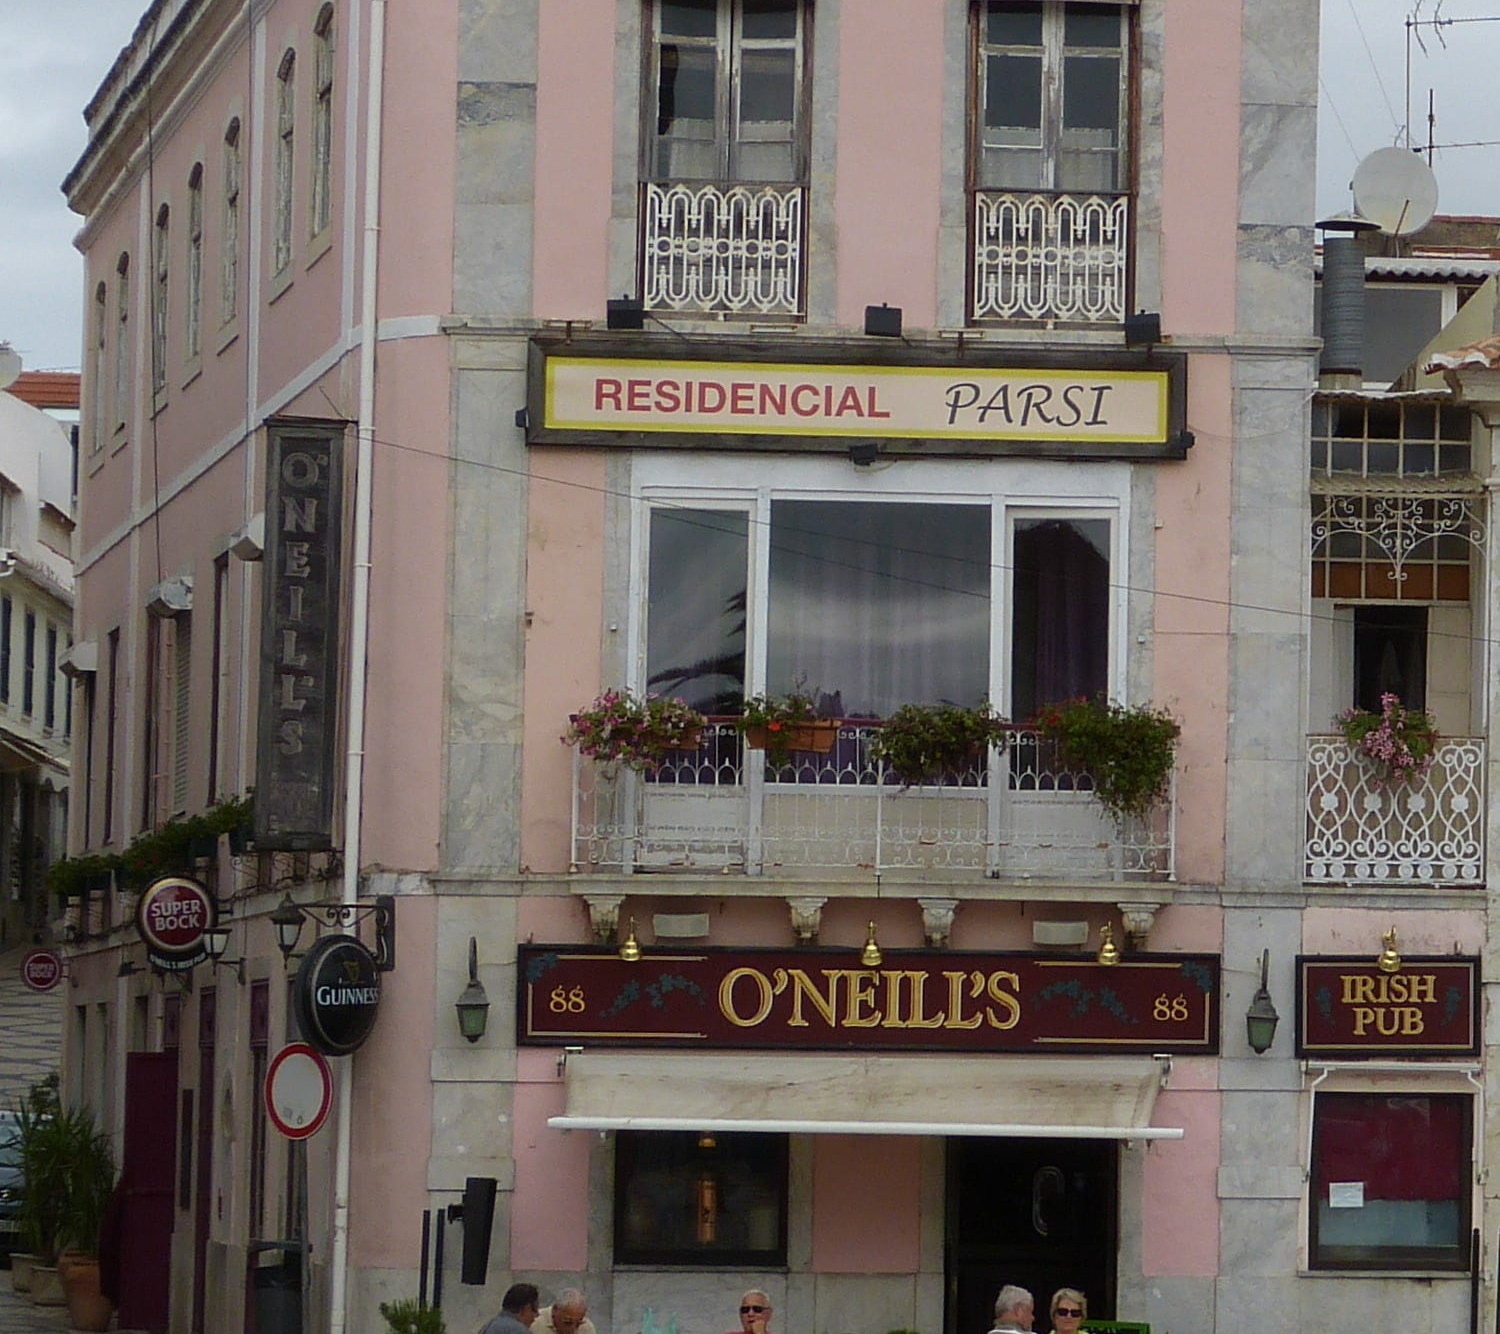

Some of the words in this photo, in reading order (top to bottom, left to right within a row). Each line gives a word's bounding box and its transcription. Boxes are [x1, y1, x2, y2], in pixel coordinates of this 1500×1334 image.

[594, 378, 891, 419] RESIDENCIAL
[945, 382, 1113, 427] PARSI
[279, 451, 329, 756] O'NEILL'S
[151, 899, 202, 917] SUPER
[155, 914, 200, 931] BOCK
[317, 986, 378, 1006] GUINNESS
[550, 985, 586, 1013] 88
[718, 967, 1021, 1030] O'NEILL'S
[1153, 992, 1188, 1021] 88
[1340, 974, 1438, 1003] IRISH
[1352, 1007, 1425, 1035] PUB
